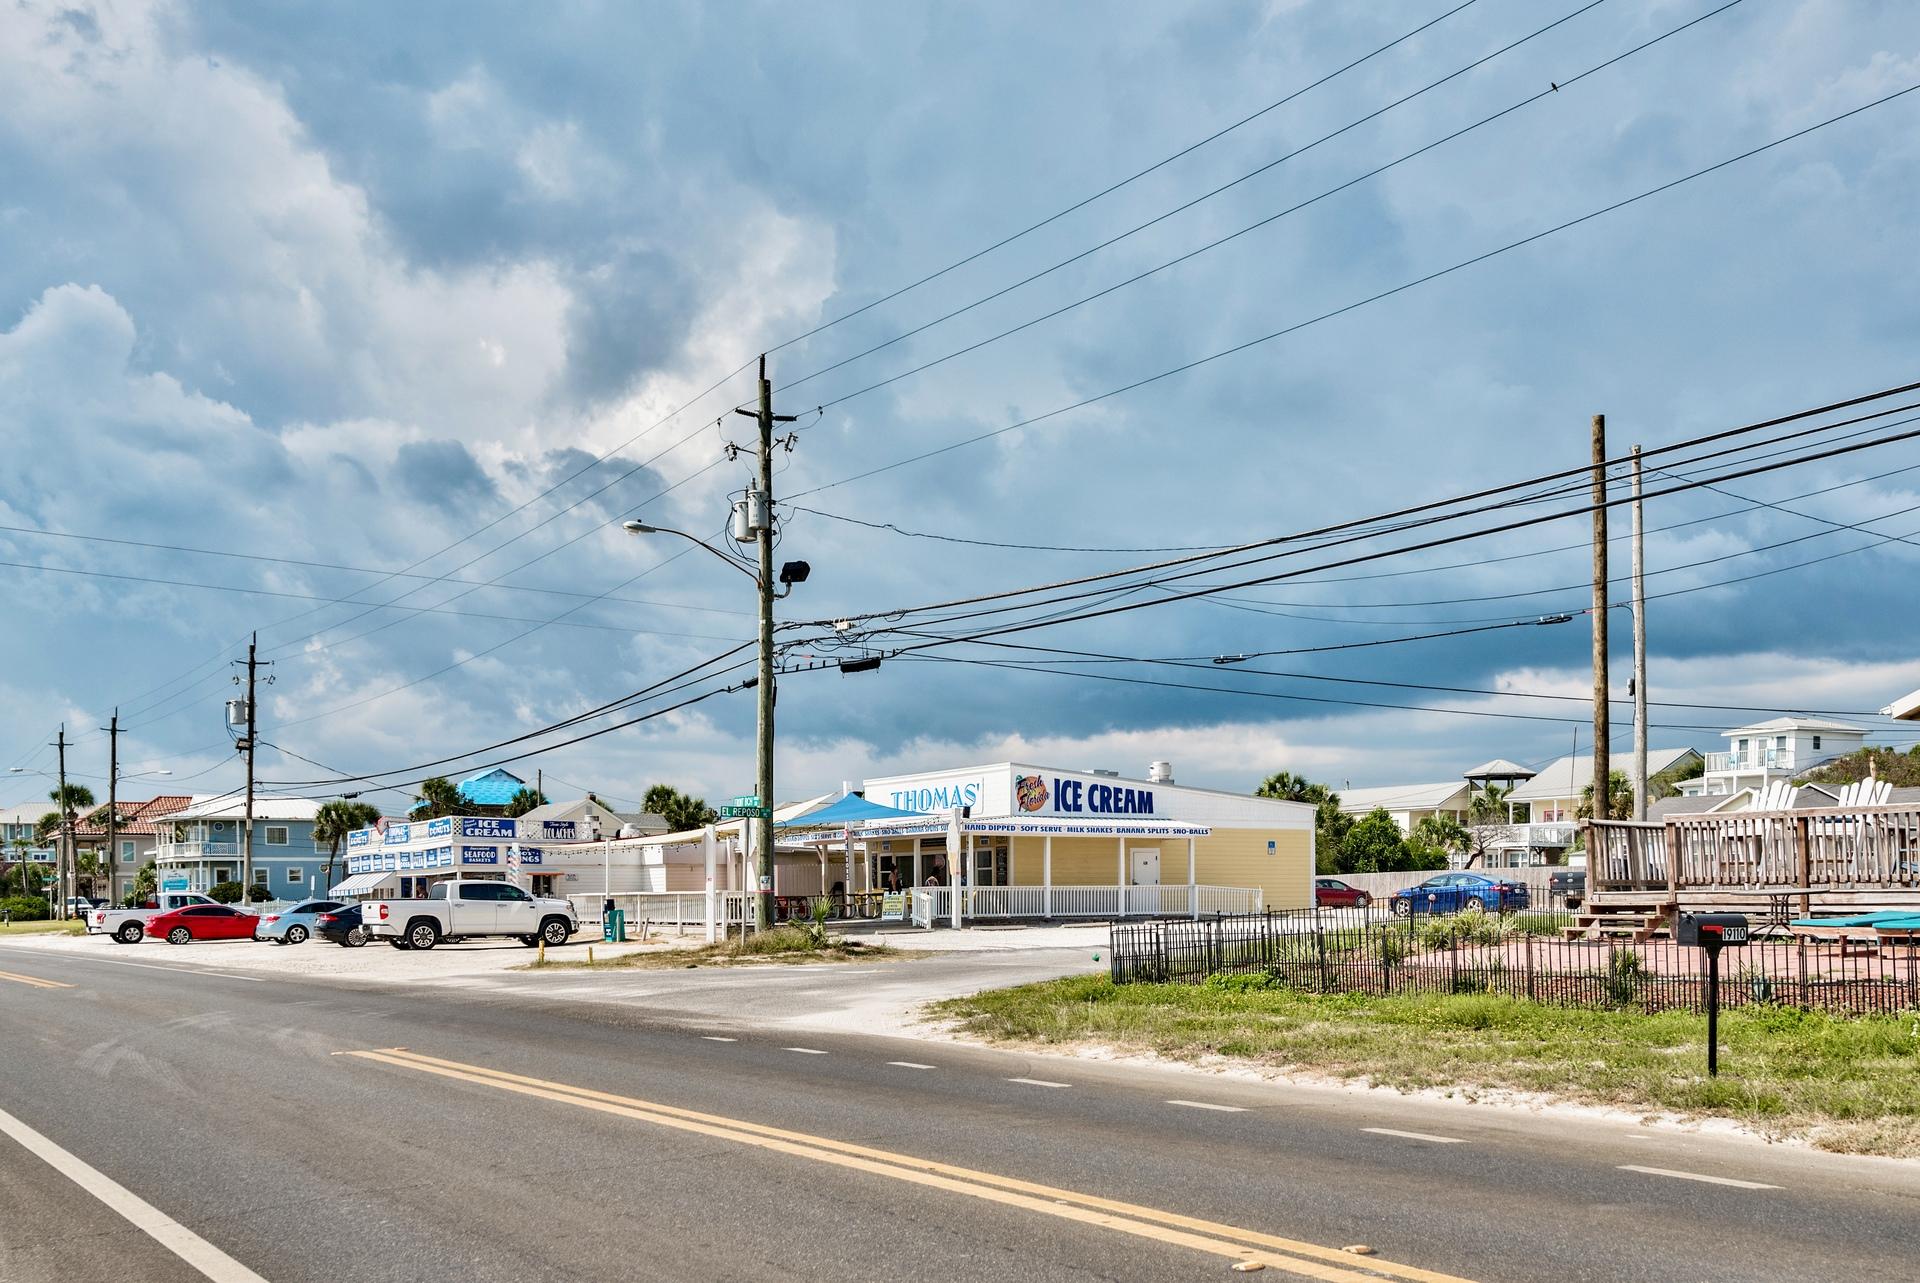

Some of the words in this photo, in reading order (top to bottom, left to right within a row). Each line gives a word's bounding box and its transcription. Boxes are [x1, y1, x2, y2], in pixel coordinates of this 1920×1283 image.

[1017, 775, 1043, 796] Fresh
[890, 783, 980, 812] THOMAS'
[1054, 778, 1082, 812] ICE
[1088, 784, 1154, 814] CREAM
[1019, 792, 1050, 812] Florida
[721, 807, 731, 816] EL
[732, 807, 760, 817] REPOSO
[478, 820, 500, 828] ICE
[988, 824, 1016, 832] DIPPED
[1147, 827, 1170, 835] SPLITS
[465, 828, 513, 837] CREAM
[464, 850, 496, 858] SEAFOOD
[1723, 928, 1746, 940] 19110
